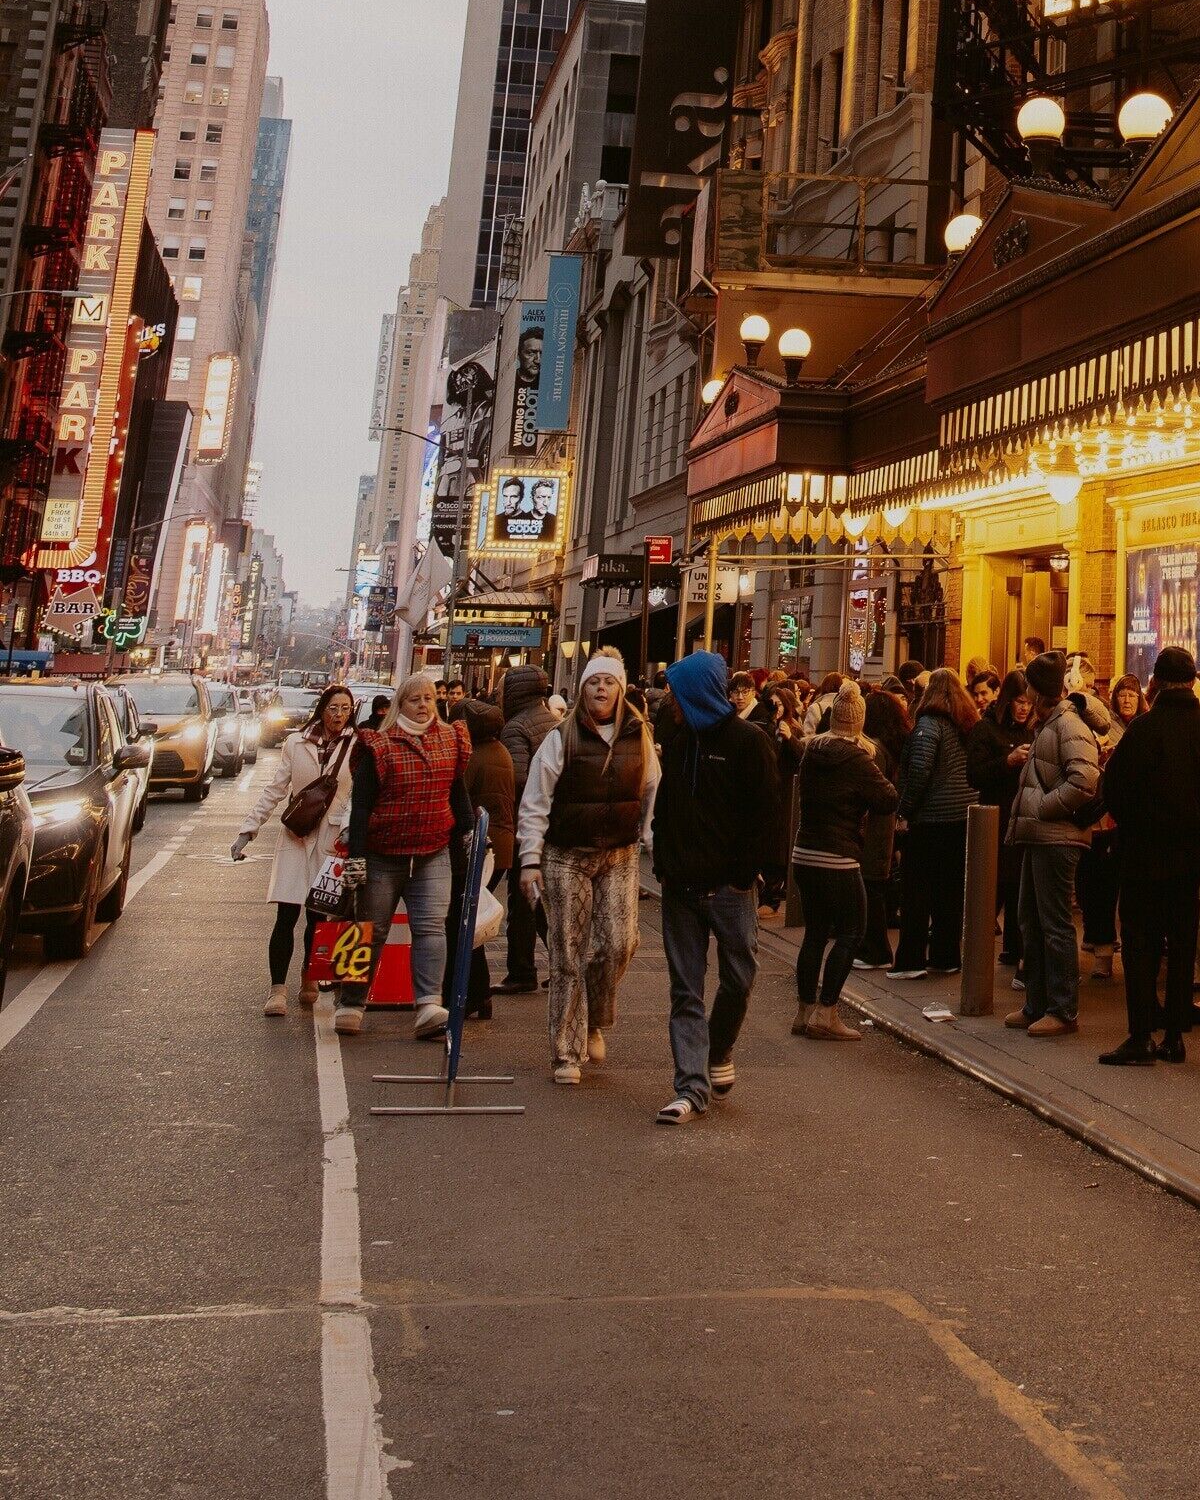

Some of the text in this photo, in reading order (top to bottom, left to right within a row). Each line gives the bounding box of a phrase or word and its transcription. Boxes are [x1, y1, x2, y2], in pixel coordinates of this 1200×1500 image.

[83, 150, 127, 270] PARK
[558, 310, 569, 351] HUDSON
[552, 351, 565, 402] THEATRE
[54, 348, 98, 474] PARK
[512, 388, 527, 447] WAITING FOR
[522, 387, 539, 447] GODOT
[440, 501, 474, 511] Discoery
[507, 524, 542, 534] GODOT
[1141, 515, 1177, 533] BELASCO
[600, 560, 630, 573] aka.
[57, 569, 101, 584] BBQ
[692, 592, 721, 601] TROS
[698, 583, 722, 591] DEX
[54, 603, 95, 614] BAR
[1161, 590, 1198, 614] MAYBE
[1161, 615, 1198, 639] HAPPY
[316, 874, 341, 894] NY
[313, 890, 340, 906] GIFTS
